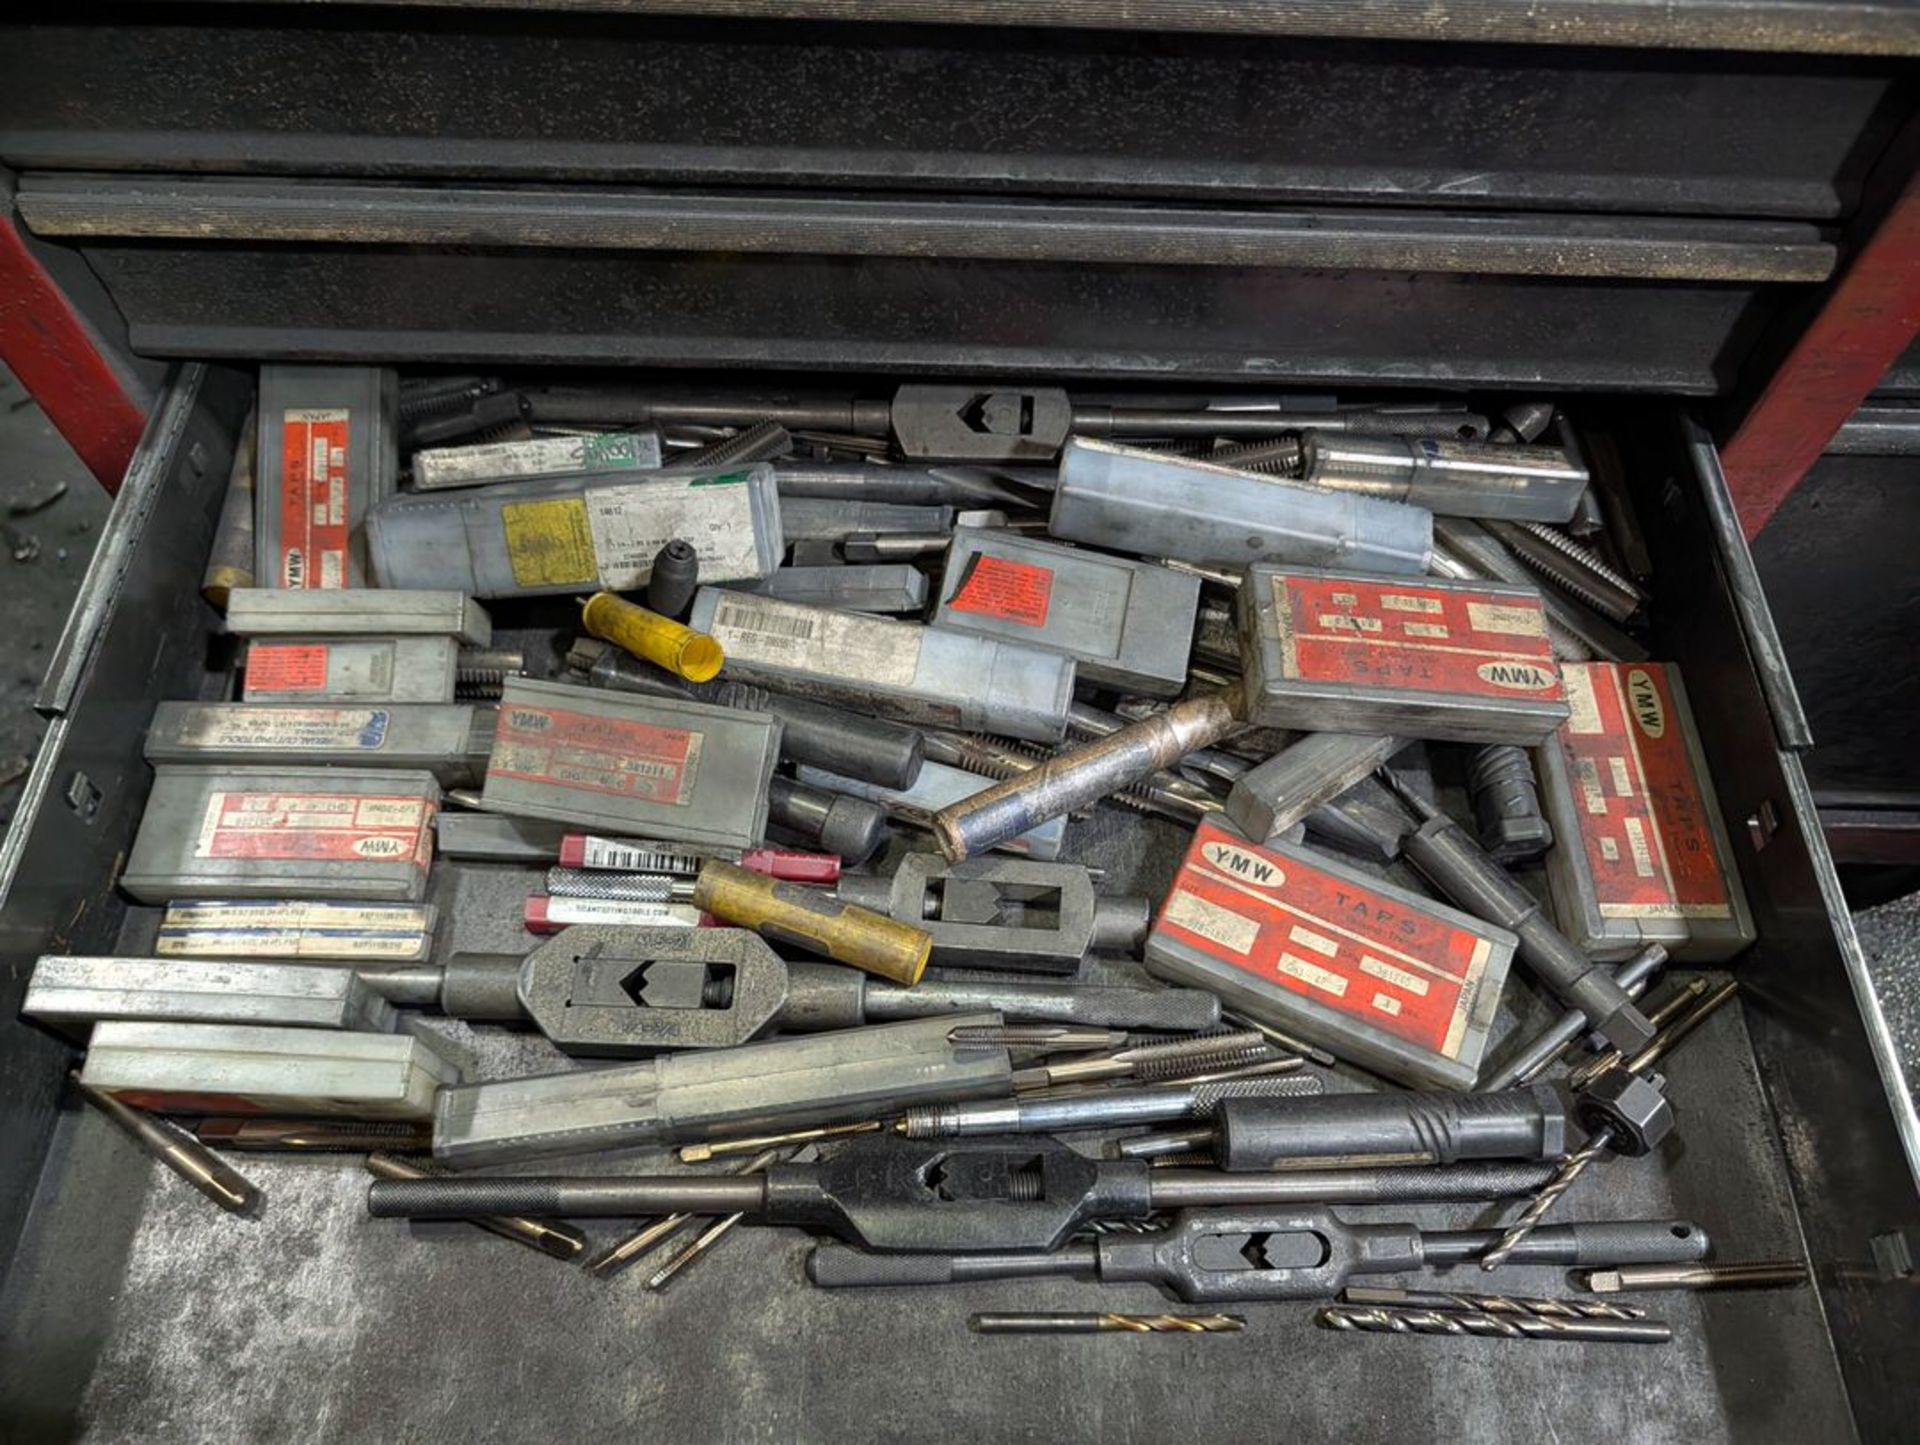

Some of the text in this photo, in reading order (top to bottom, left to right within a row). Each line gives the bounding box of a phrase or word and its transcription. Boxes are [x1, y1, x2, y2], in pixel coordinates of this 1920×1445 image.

[288, 553, 303, 589] YMW
[1353, 660, 1434, 680] TAPS
[1491, 667, 1547, 686] YMW
[511, 711, 549, 729] YMW
[1633, 680, 1661, 729] YMW
[1670, 779, 1699, 851] TAPS
[360, 841, 400, 854] YMW
[1216, 846, 1274, 883] YMW
[1336, 892, 1416, 935] TAPS
[1458, 980, 1476, 1011] JAPAN
